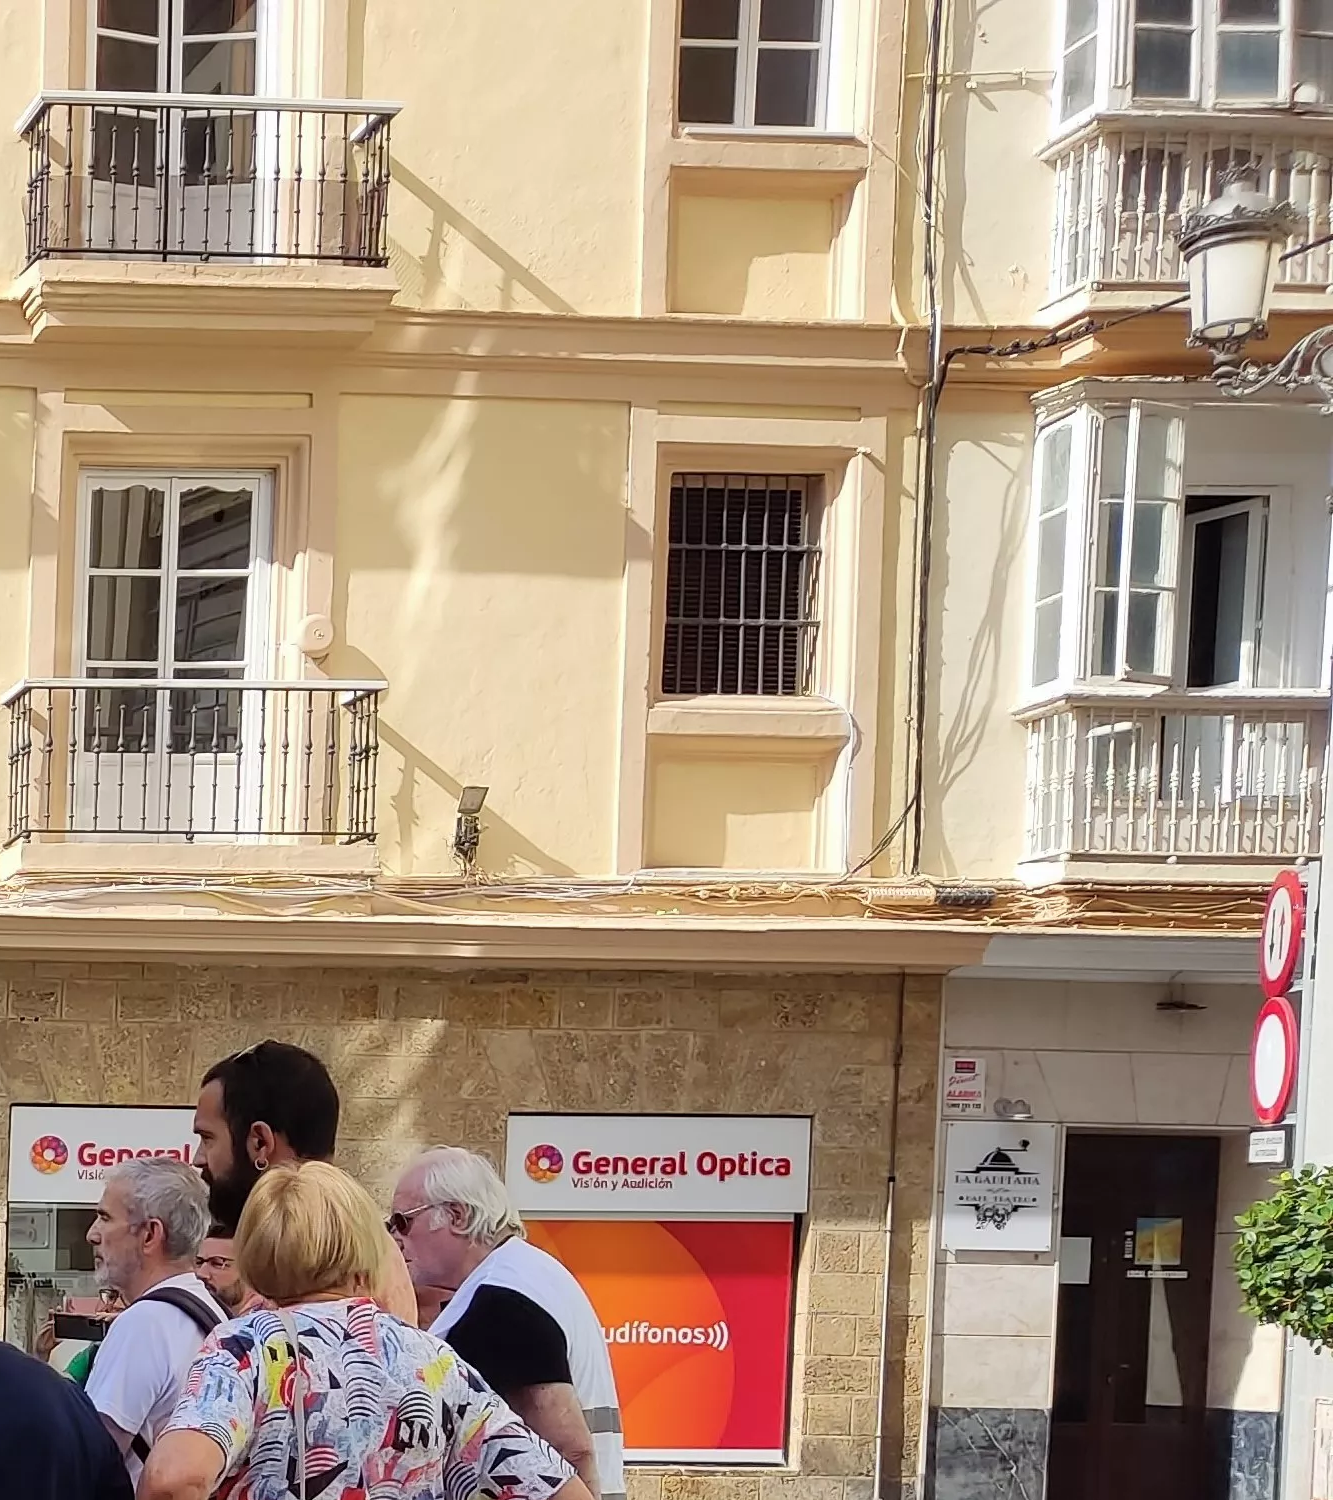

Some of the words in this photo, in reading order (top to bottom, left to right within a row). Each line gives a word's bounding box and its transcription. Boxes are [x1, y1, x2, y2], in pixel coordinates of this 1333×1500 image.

[77, 1168, 105, 1181] Visió
[572, 1151, 688, 1176] General
[696, 1151, 791, 1182] Optica
[572, 1177, 608, 1189] Visión
[611, 1180, 618, 1191] y
[621, 1177, 673, 1190] Audición
[600, 1320, 707, 1344] udífonos
